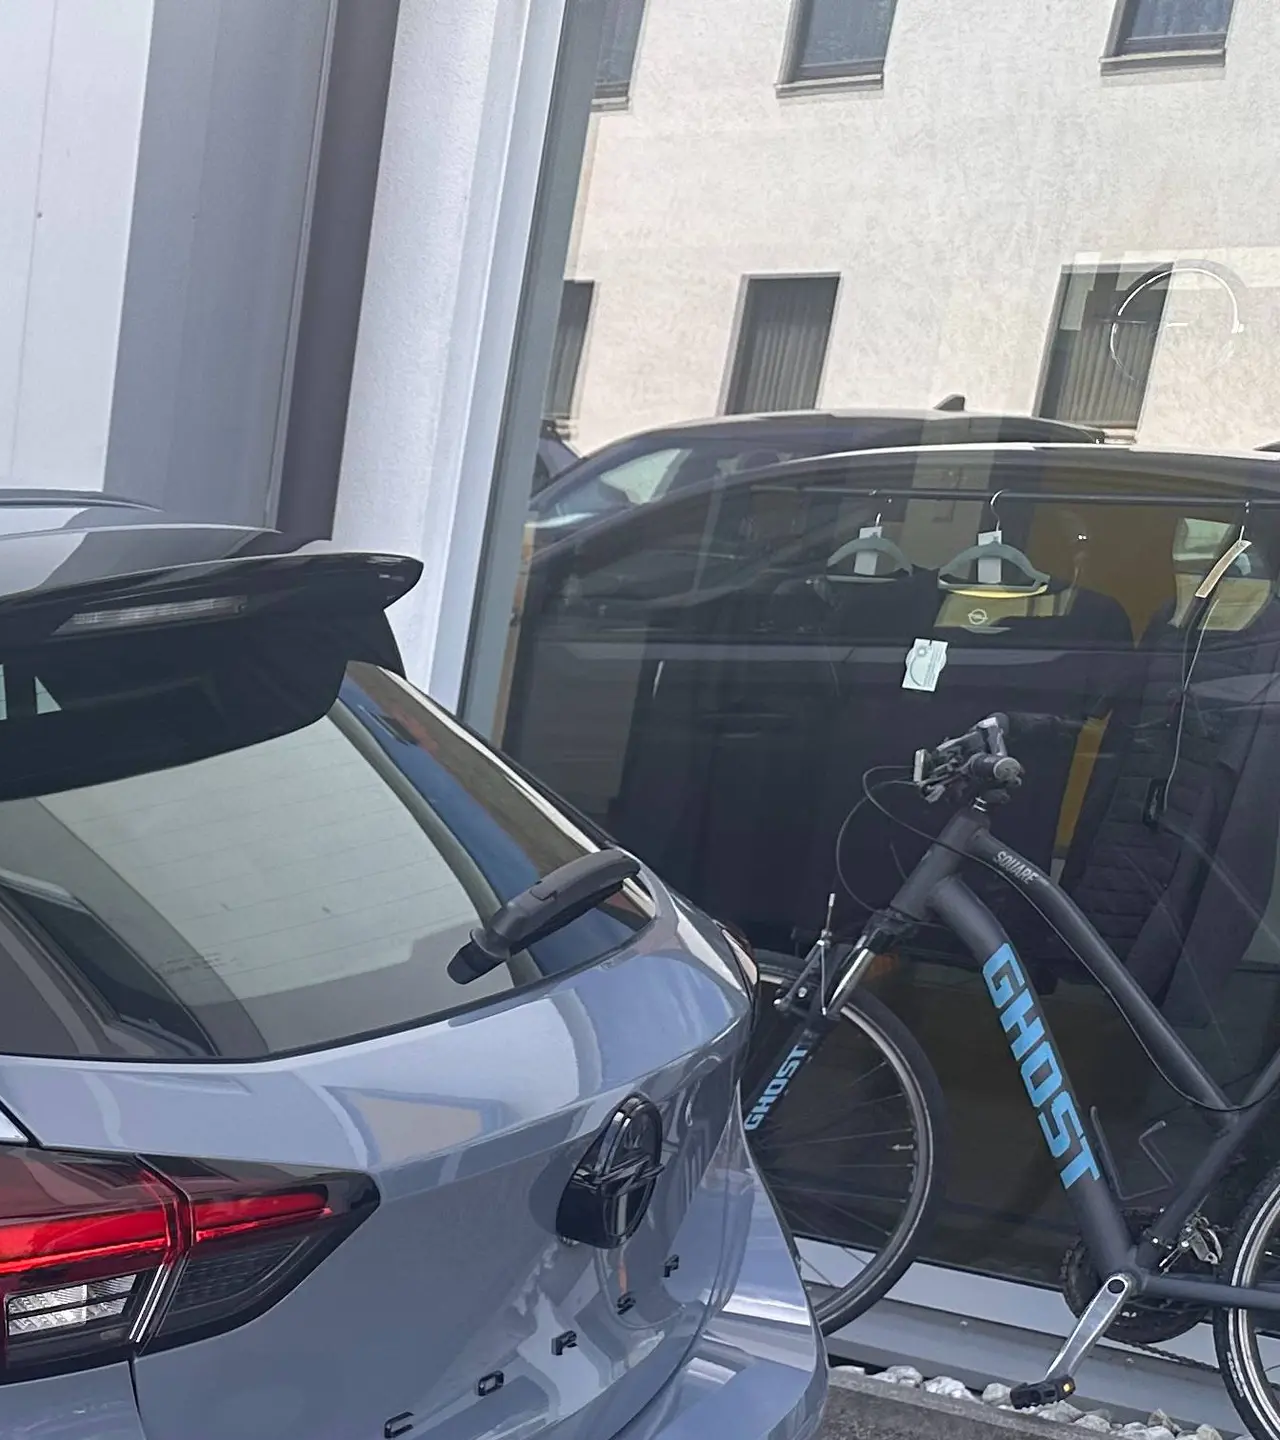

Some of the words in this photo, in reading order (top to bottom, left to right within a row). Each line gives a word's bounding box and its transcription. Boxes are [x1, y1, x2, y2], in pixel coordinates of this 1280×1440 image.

[993, 851, 1040, 885] SQUARE
[743, 1042, 810, 1131] GHOST
[982, 942, 1101, 1190] GHOST
